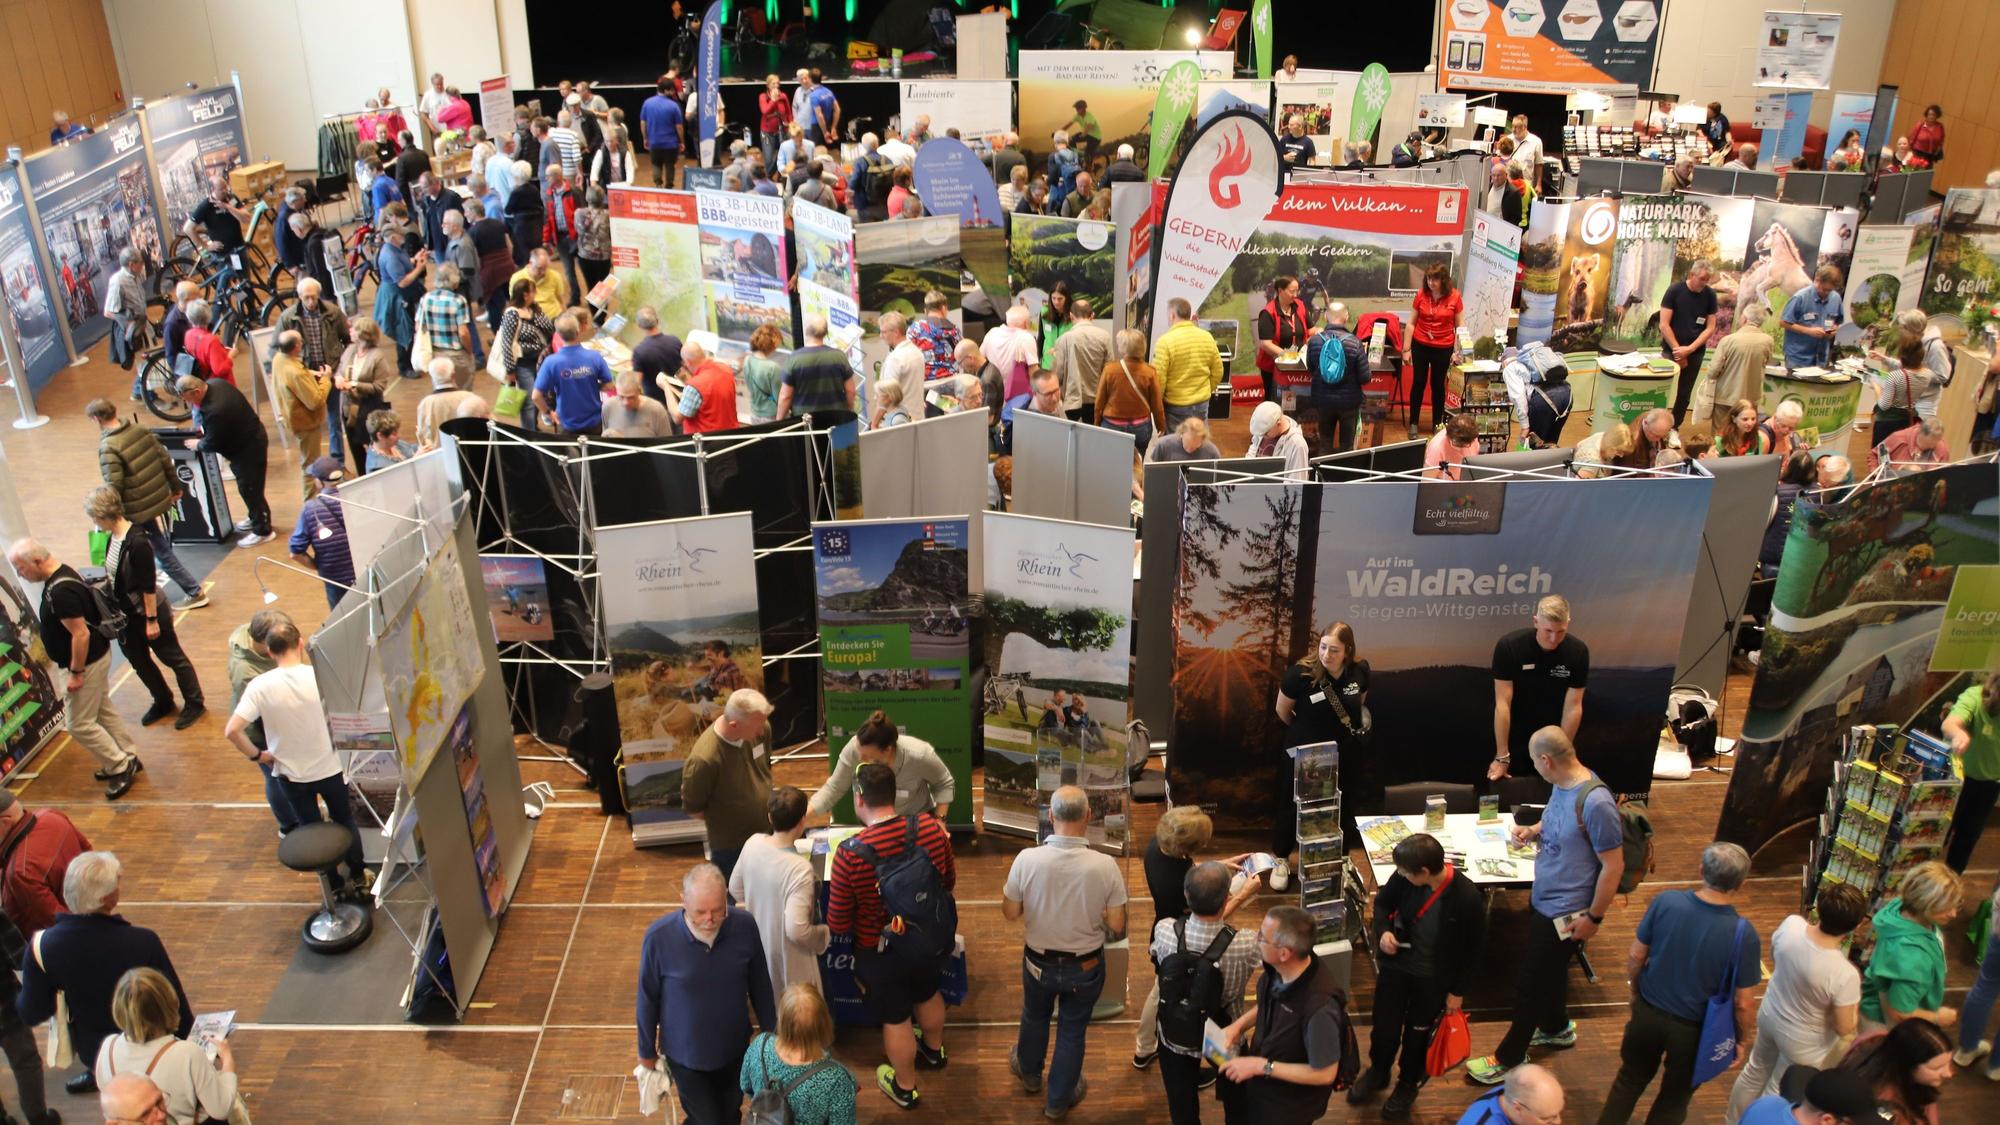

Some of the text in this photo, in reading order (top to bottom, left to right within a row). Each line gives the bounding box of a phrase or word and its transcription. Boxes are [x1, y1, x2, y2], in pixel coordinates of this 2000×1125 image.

[904, 84, 955, 99] Tambiente
[192, 104, 225, 123] FELD
[113, 134, 136, 154] FELD
[701, 195, 779, 216] Das 3B-LAND
[1283, 196, 1326, 211] dem
[1331, 196, 1406, 213] Vulkan
[1618, 203, 1702, 221] NATURPARK
[701, 207, 780, 229] BBBegeistert
[795, 205, 850, 235] Das 3B-LAND
[1168, 217, 1242, 252] GEDERN
[1616, 220, 1699, 240] HOHE MARK
[1185, 242, 1201, 254] die
[1238, 245, 1372, 257] ulkanstadt Gedern
[1164, 249, 1220, 278] Vulkanstadt
[1172, 273, 1206, 290] am See
[1934, 273, 1992, 297] So geht
[1232, 389, 1264, 398] www.
[1806, 407, 1830, 417] HOHE
[1425, 508, 1446, 519] Echt
[828, 537, 842, 548] 15
[1017, 558, 1061, 576] Rhein
[1366, 556, 1415, 568] Auf ins
[635, 562, 682, 582] Rhein
[1346, 564, 1552, 598] WaldReich
[1349, 601, 1537, 621] Siegen-Wittgenstei
[1956, 604, 2000, 626] berg
[826, 639, 885, 650] Entdecken Sie
[827, 650, 877, 665] Europa!
